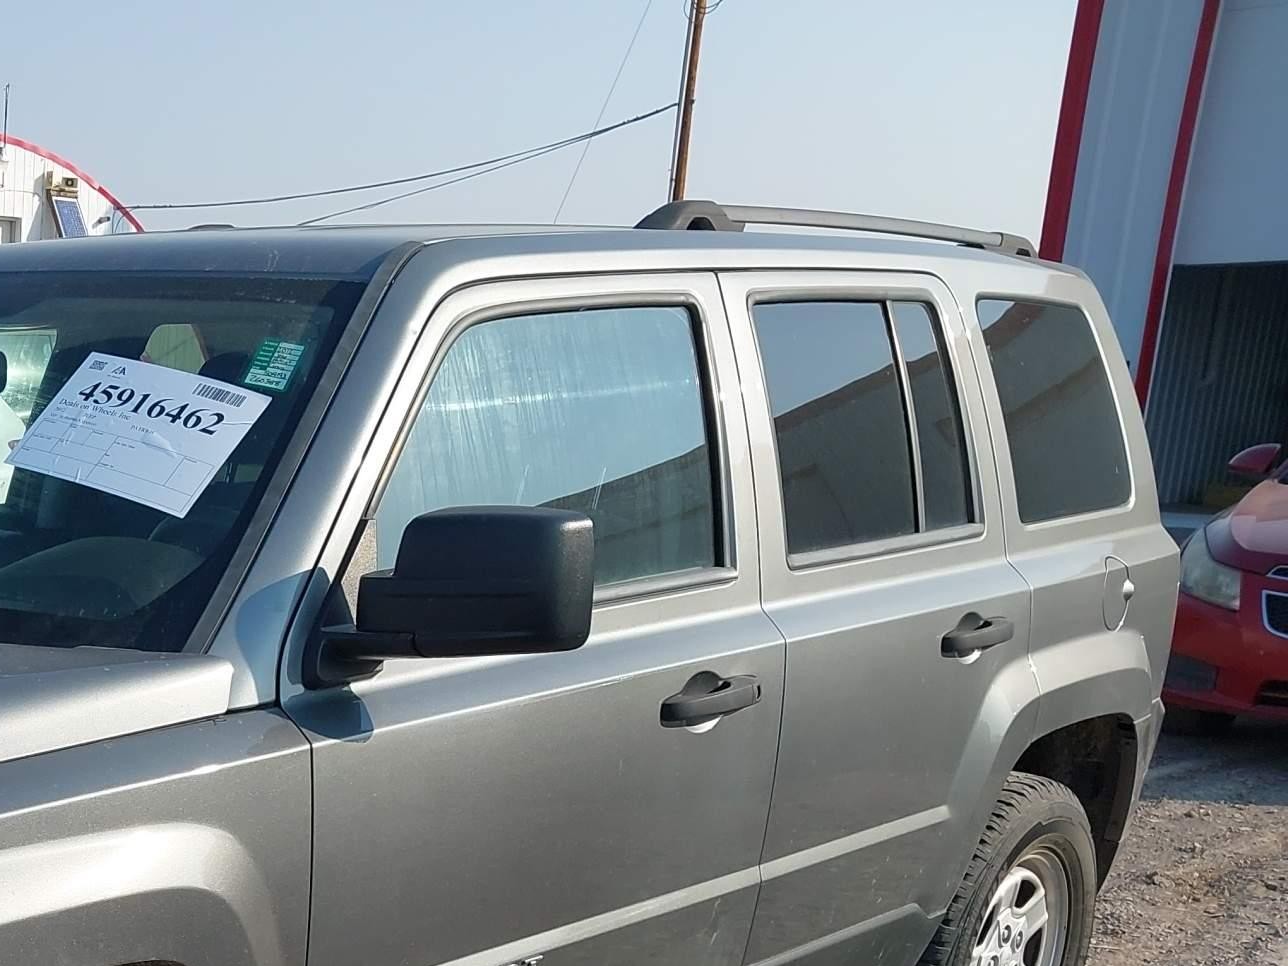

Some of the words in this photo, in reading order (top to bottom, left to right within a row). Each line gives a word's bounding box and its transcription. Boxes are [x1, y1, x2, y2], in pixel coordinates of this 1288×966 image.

[58, 398, 79, 410] Deals
[91, 404, 117, 418] Wheels
[118, 412, 132, 421] Inc
[78, 381, 225, 435] 45916462
